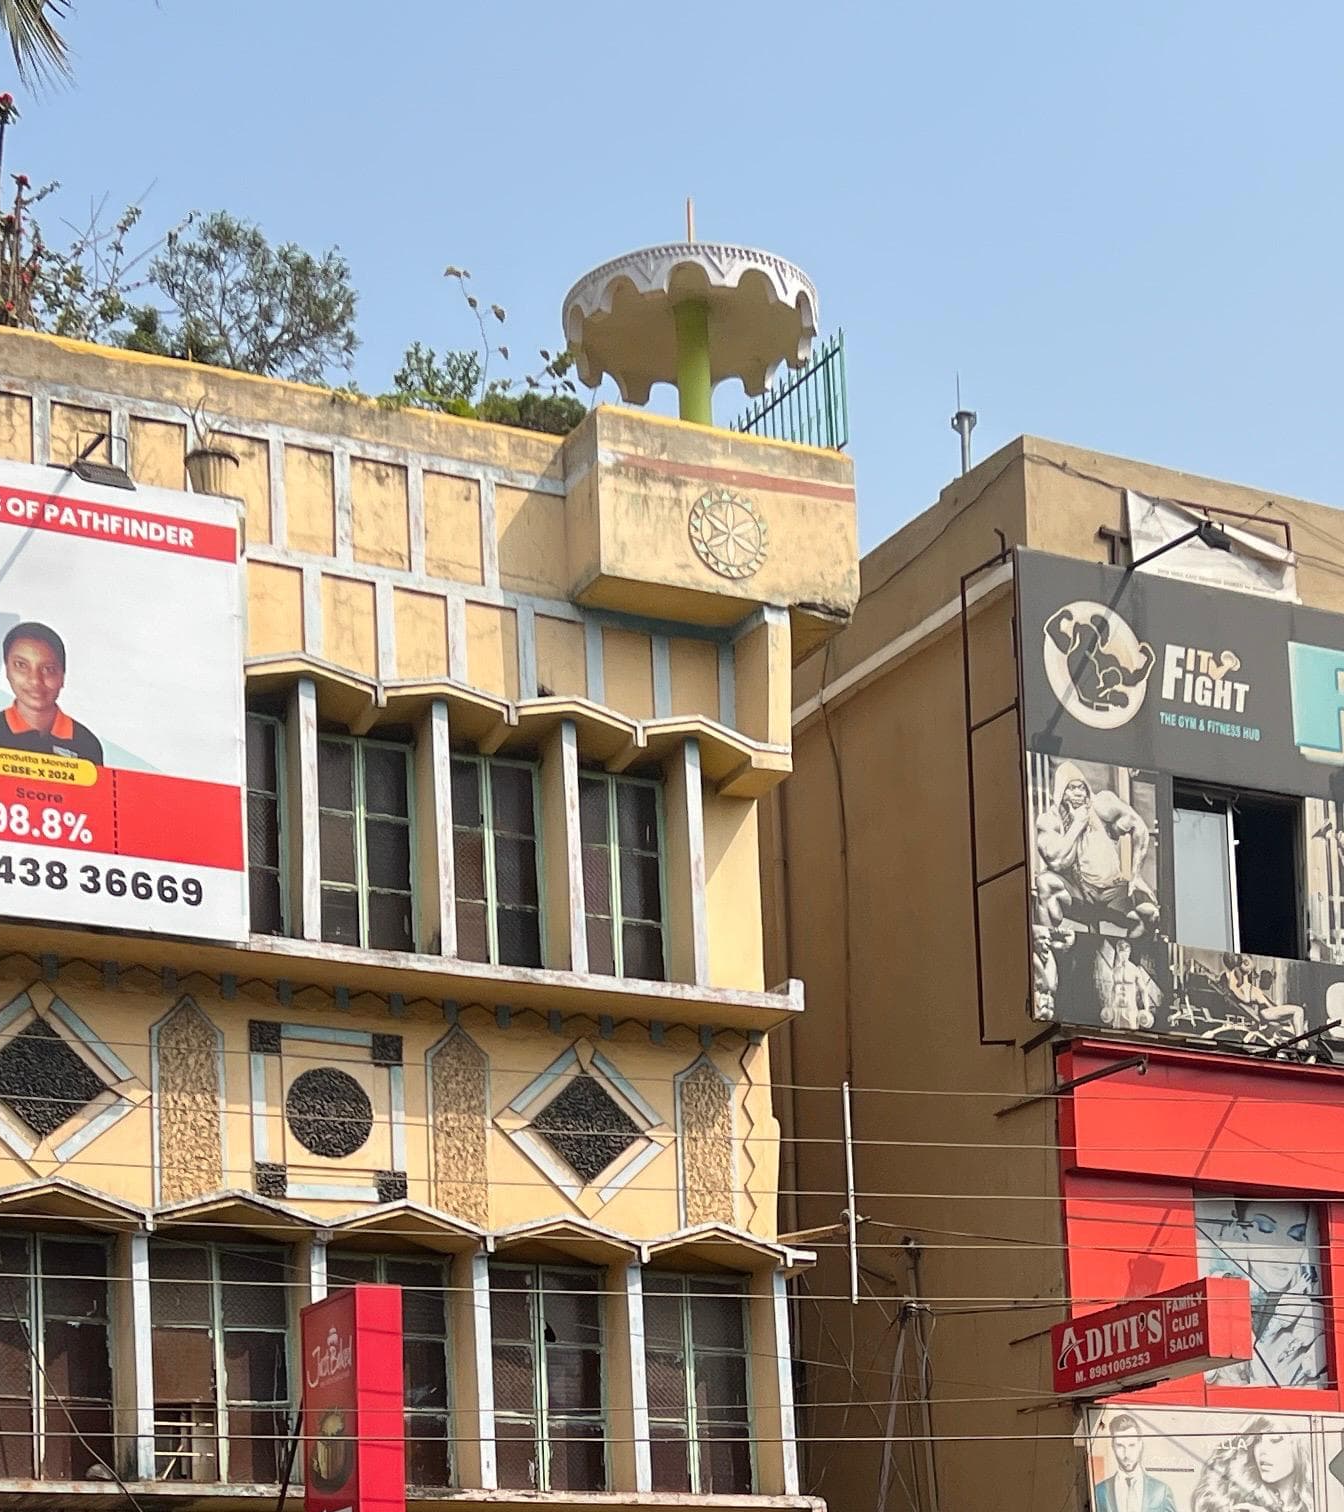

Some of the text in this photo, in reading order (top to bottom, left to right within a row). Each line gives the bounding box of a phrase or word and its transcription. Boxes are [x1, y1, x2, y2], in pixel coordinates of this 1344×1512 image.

[6, 498, 41, 521] OF
[44, 502, 194, 547] PATHFINDER
[1160, 711, 1177, 725] THE
[1179, 716, 1197, 731] GYM
[1207, 720, 1241, 738] FITNESS
[2, 764, 75, 782] CBSE-X 2024
[16, 787, 63, 804] Score
[79, 863, 205, 907] 36669
[1165, 1291, 1204, 1315] FAMILY
[1171, 1312, 1200, 1333] CLUB
[1057, 1309, 1163, 1371] ADITI'S
[1169, 1332, 1204, 1353] SALON
[1075, 1351, 1151, 1384] M. 8981005253
